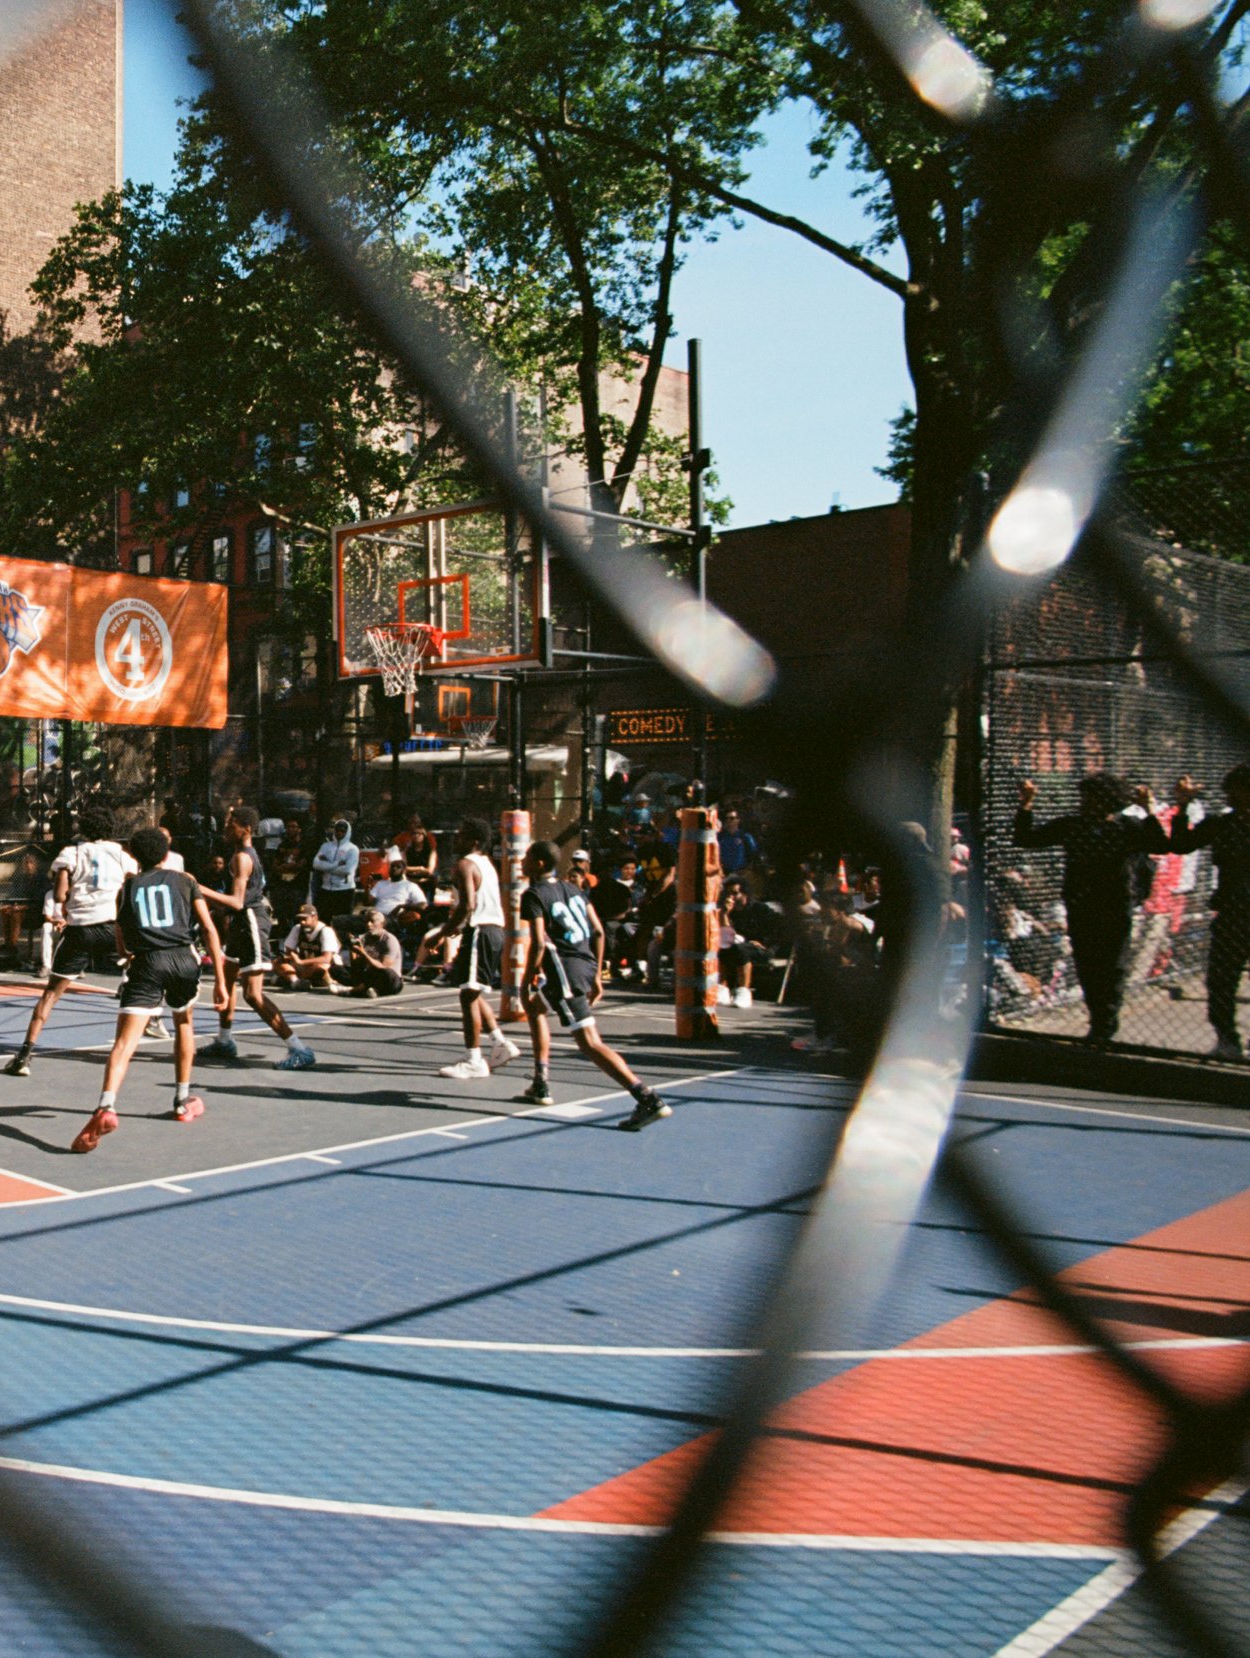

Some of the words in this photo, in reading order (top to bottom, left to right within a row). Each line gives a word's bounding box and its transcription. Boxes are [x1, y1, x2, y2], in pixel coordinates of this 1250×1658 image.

[110, 613, 129, 633] WEST
[141, 616, 161, 649] STREET
[114, 617, 146, 681] 4
[617, 716, 687, 736] COMEDY
[135, 884, 175, 928] 10
